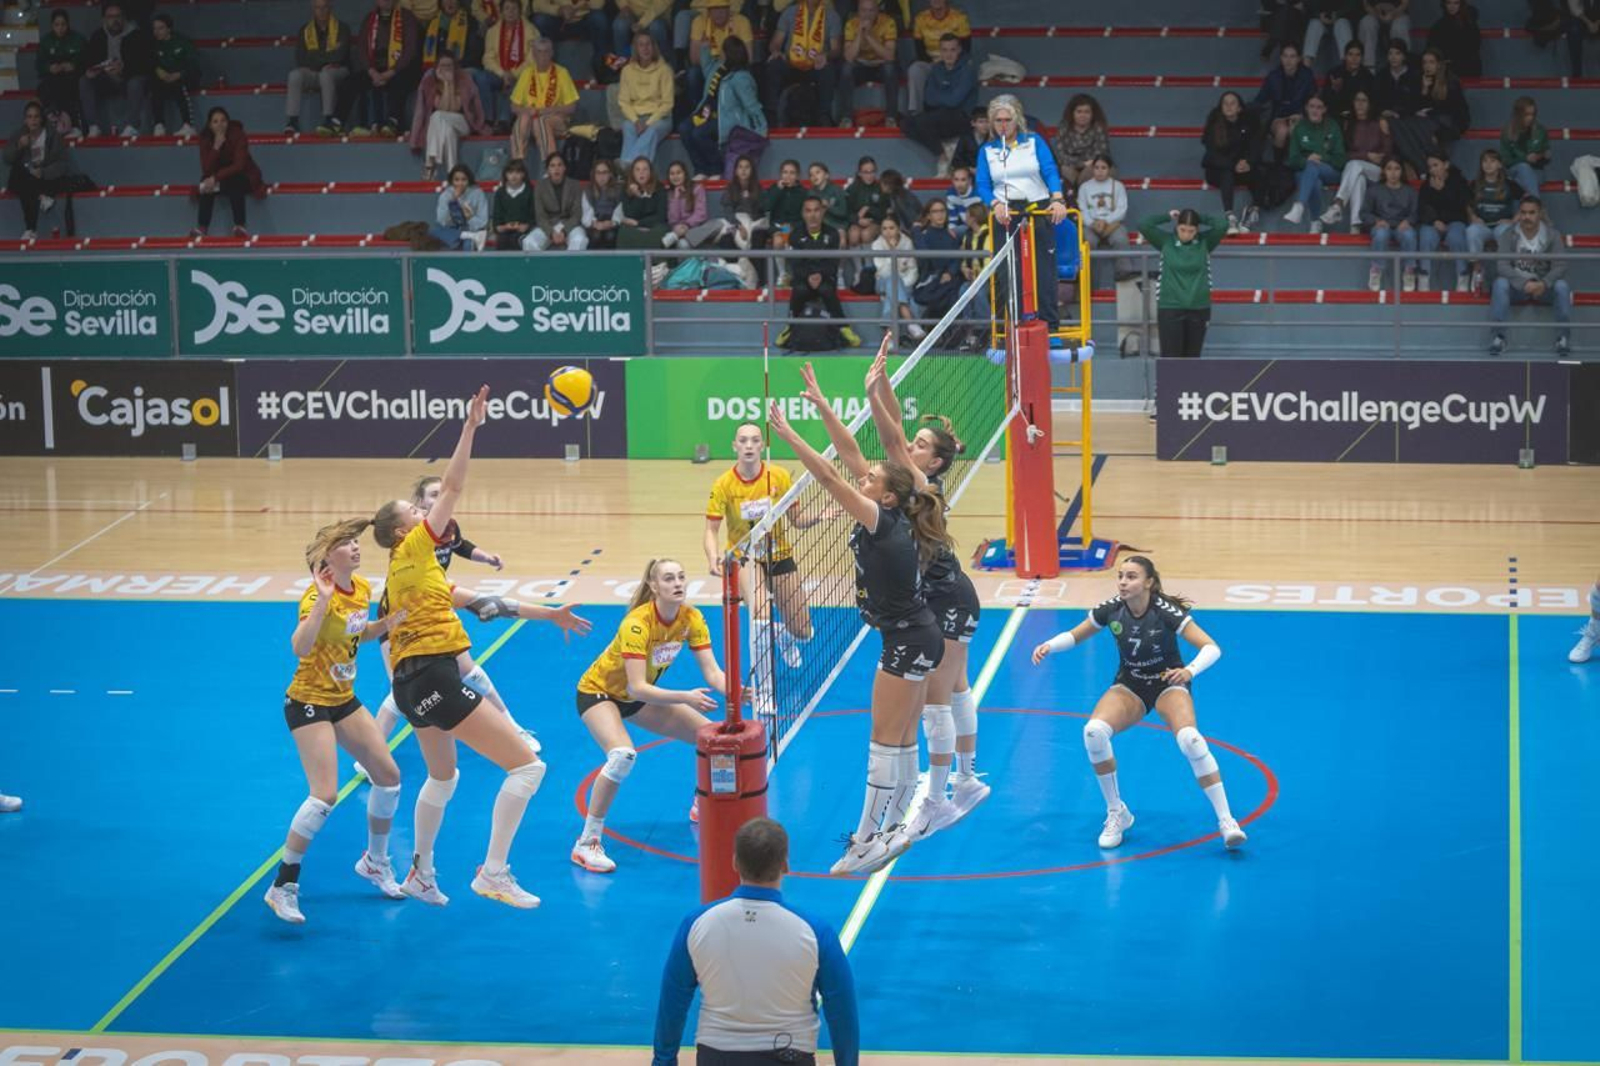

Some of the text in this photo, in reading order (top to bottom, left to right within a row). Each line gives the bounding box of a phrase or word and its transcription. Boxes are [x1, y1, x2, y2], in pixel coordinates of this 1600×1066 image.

[63, 289, 157, 310] Diputación
[291, 287, 389, 308] Diputación
[531, 285, 630, 306] Diputación
[64, 310, 157, 336] Sevilla
[293, 308, 390, 335] Sevilla
[532, 305, 631, 333] Sevilla
[77, 385, 230, 438] Cajasol
[707, 397, 761, 420] DOS
[1177, 390, 1547, 431] #CEVChallengeCupW
[942, 621, 956, 632] 12
[1128, 637, 1141, 656] 7
[890, 656, 900, 669] 2
[461, 686, 476, 700] 5
[303, 703, 316, 718] 3
